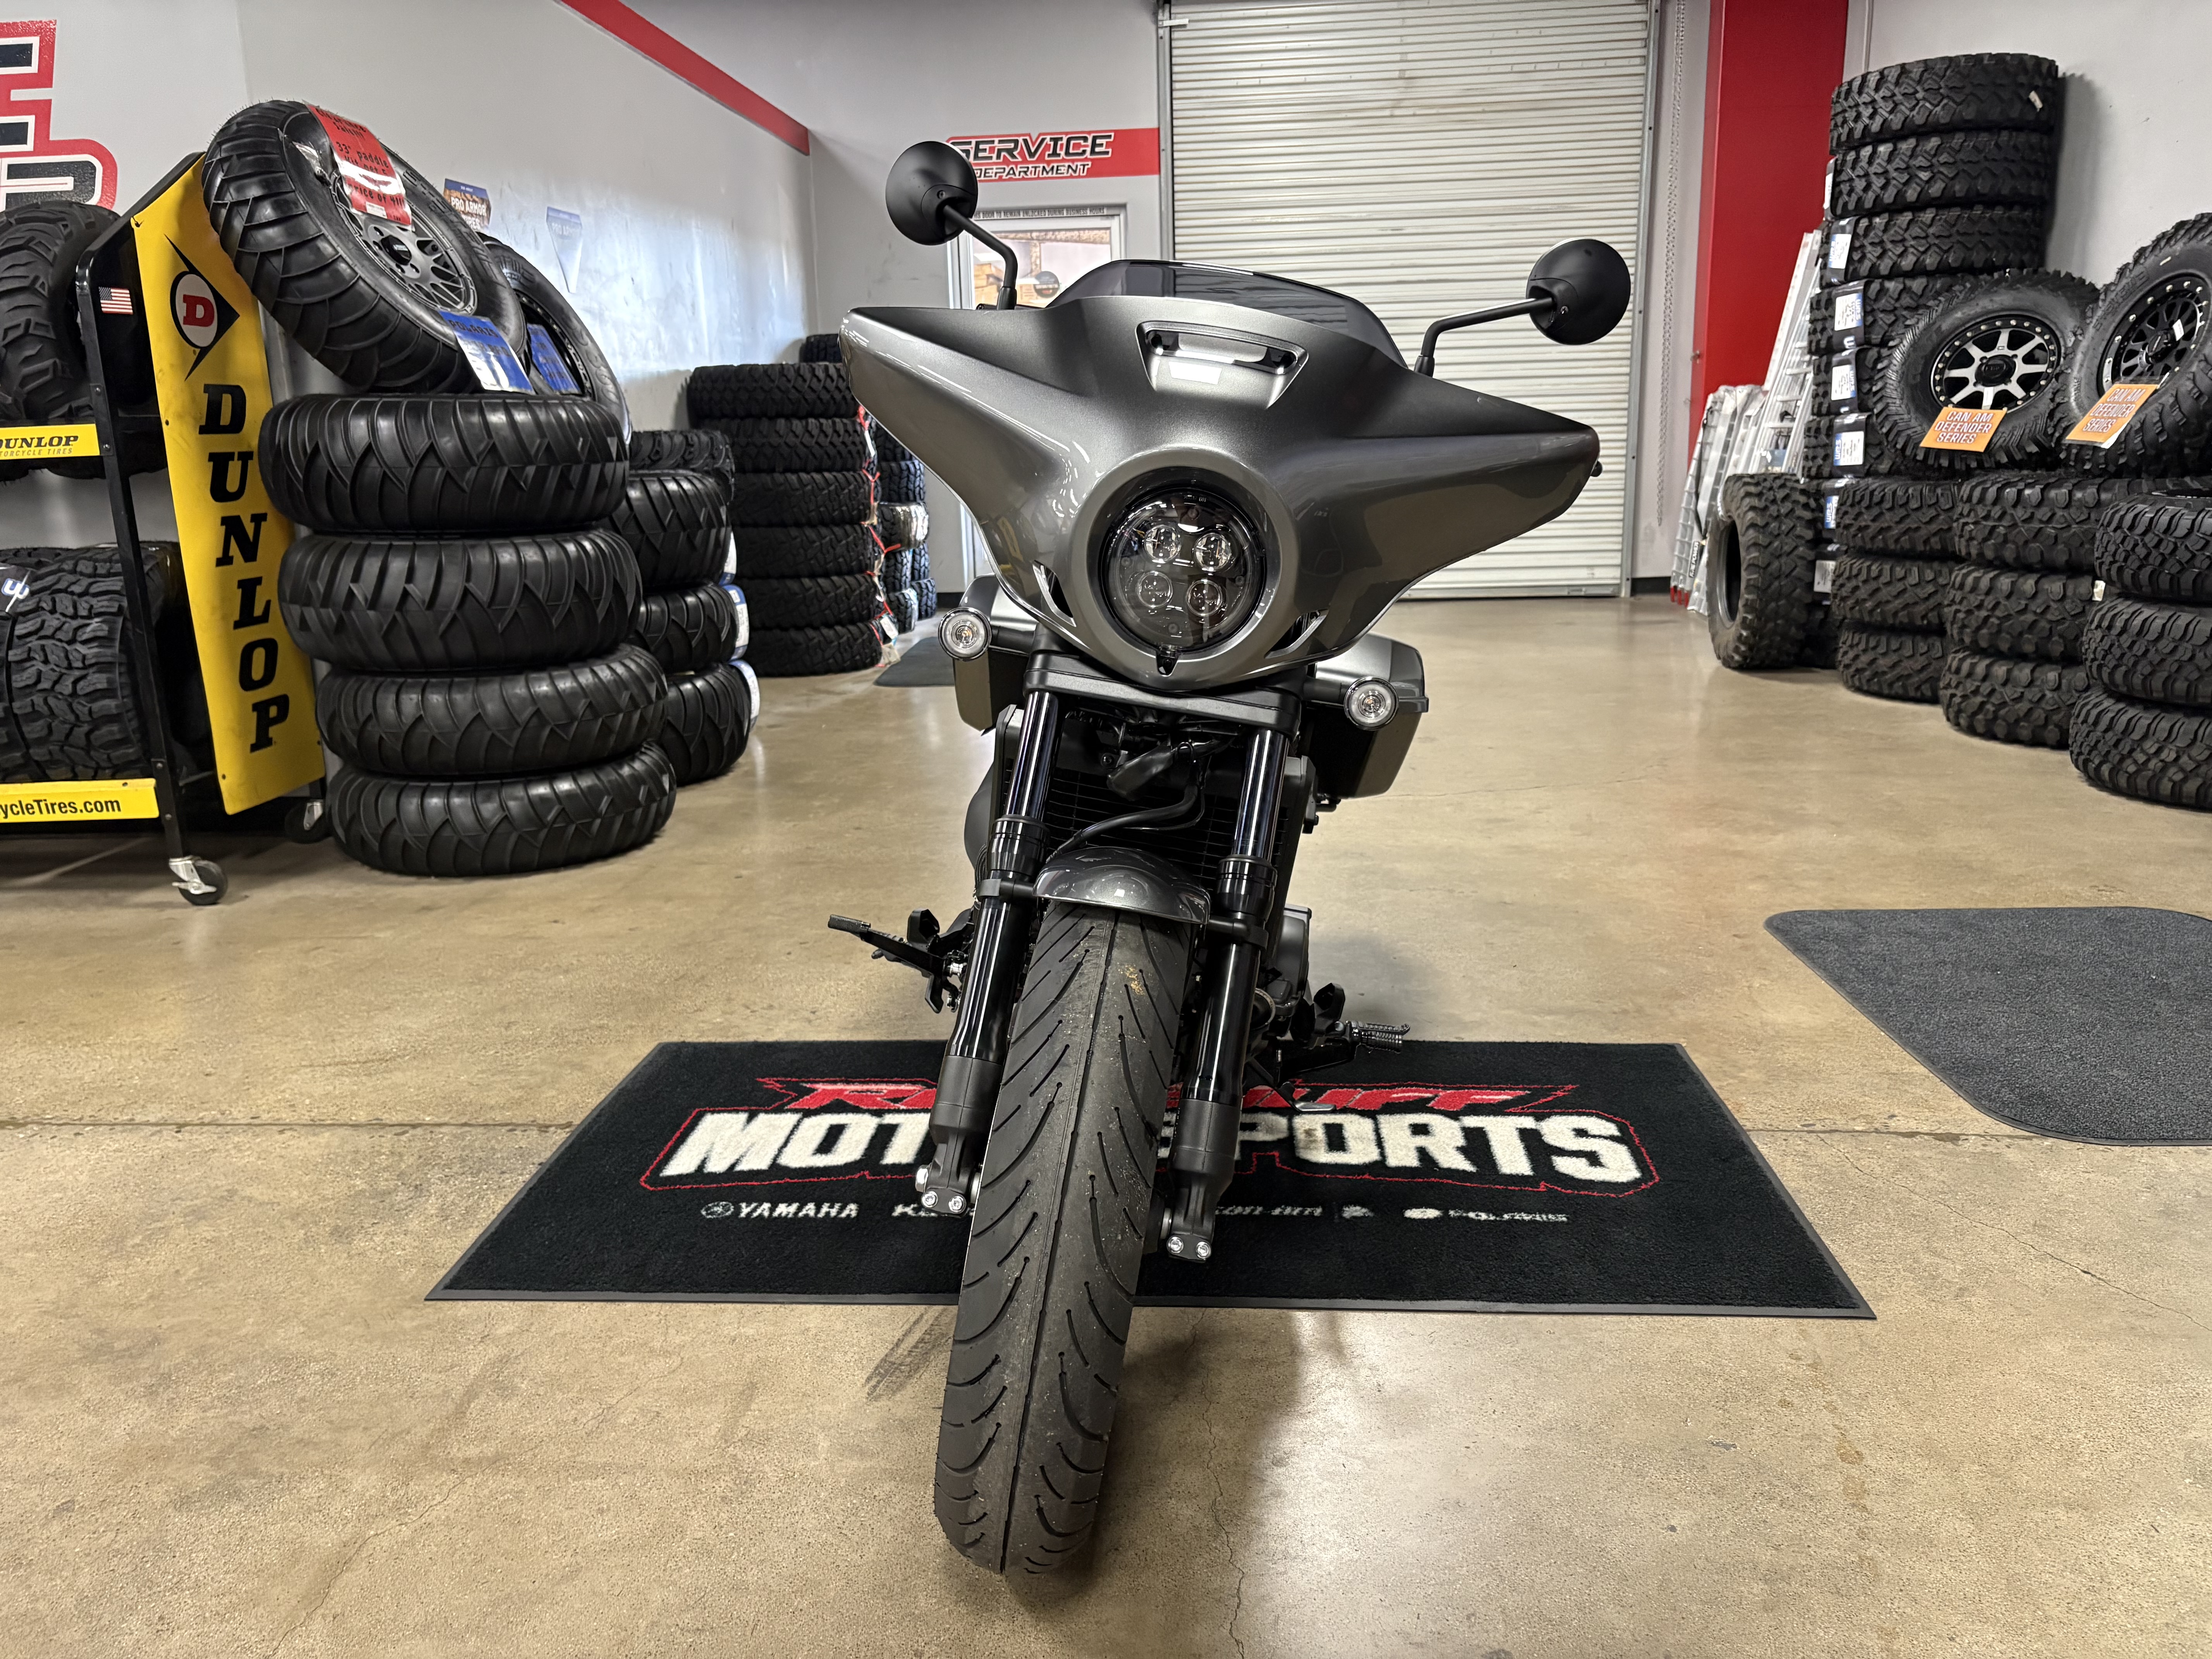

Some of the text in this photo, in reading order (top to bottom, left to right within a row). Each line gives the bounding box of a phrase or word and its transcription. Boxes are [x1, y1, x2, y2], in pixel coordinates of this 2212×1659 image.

[950, 133, 1114, 163] SERVICE
[356, 151, 389, 168] paddle
[972, 162, 1091, 179] DEPARTMENT
[378, 194, 386, 203] of
[450, 197, 487, 216] PRO ARMOR
[183, 294, 215, 327] D
[448, 319, 499, 338] POLARIS
[2107, 388, 2146, 402] CAN AM
[1947, 411, 1993, 422] CAN AM
[2090, 403, 2136, 417] DEFENDER
[1934, 421, 1992, 433] DEFENDER
[2082, 418, 2116, 433] SERIES
[1937, 432, 1977, 444] SERIES
[199, 383, 289, 753] DUNLOP
[0, 799, 121, 819] ycleTires.com
[738, 1201, 860, 1218] YAMAHA
